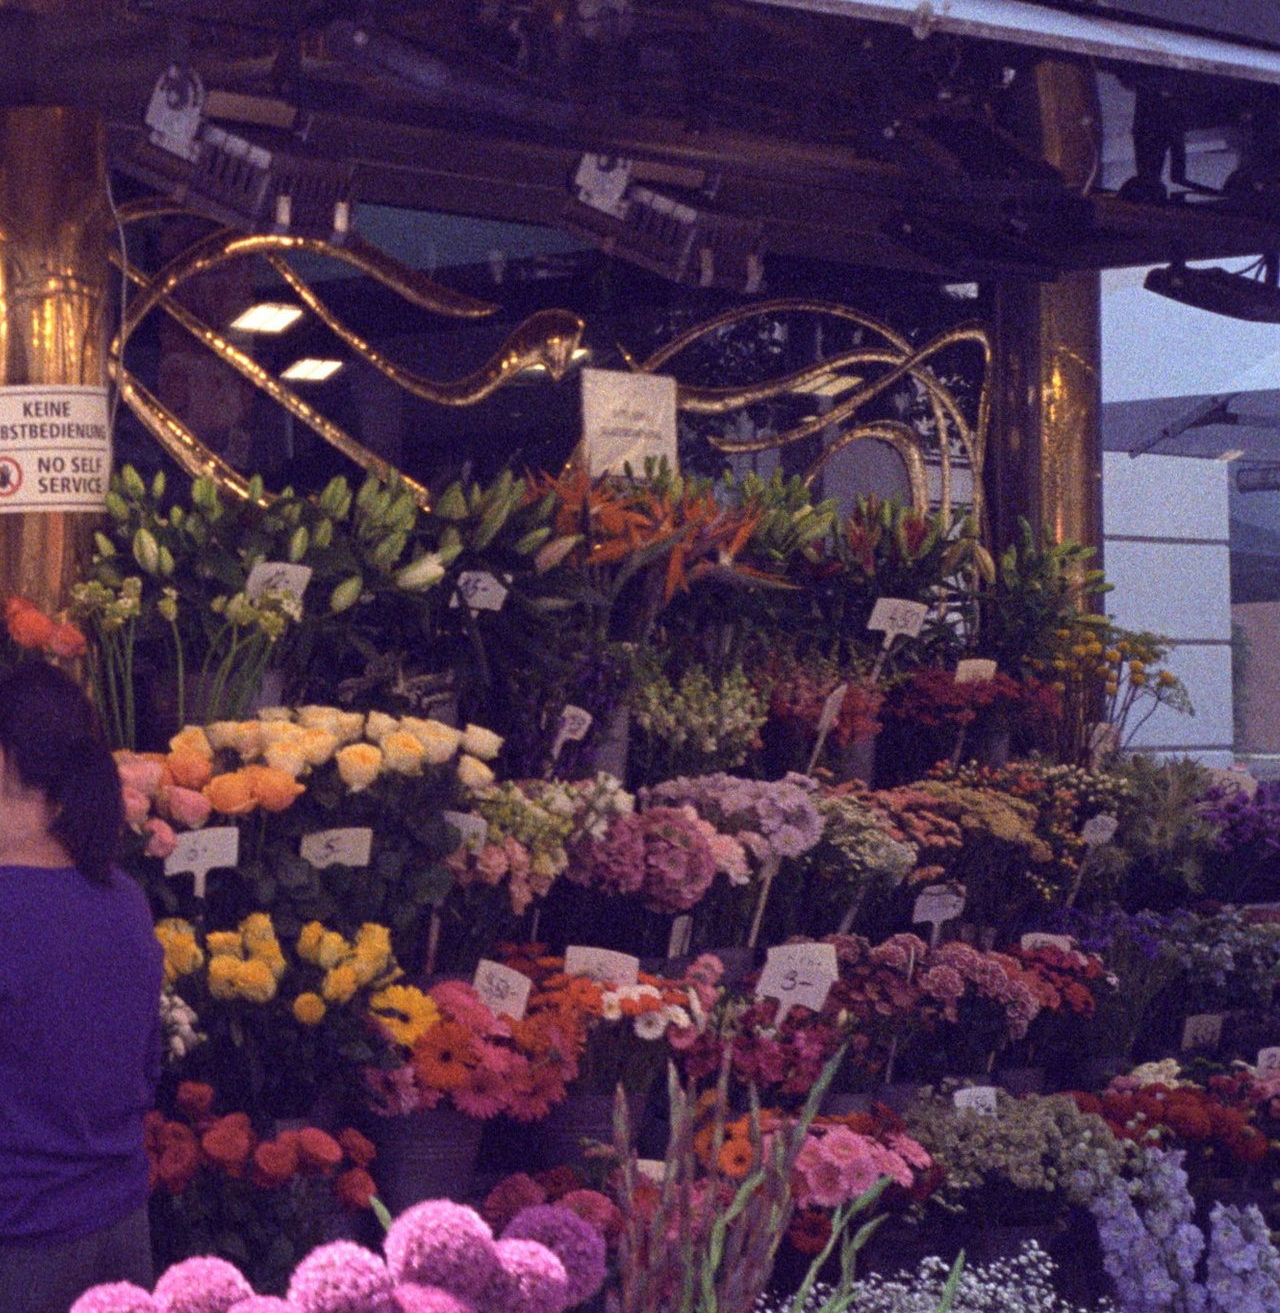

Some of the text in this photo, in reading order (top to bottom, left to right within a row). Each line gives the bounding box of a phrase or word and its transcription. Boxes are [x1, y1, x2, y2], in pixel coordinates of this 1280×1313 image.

[22, 400, 72, 418] KEINE
[37, 456, 103, 474] NO SELF
[37, 476, 103, 495] SERVICE
